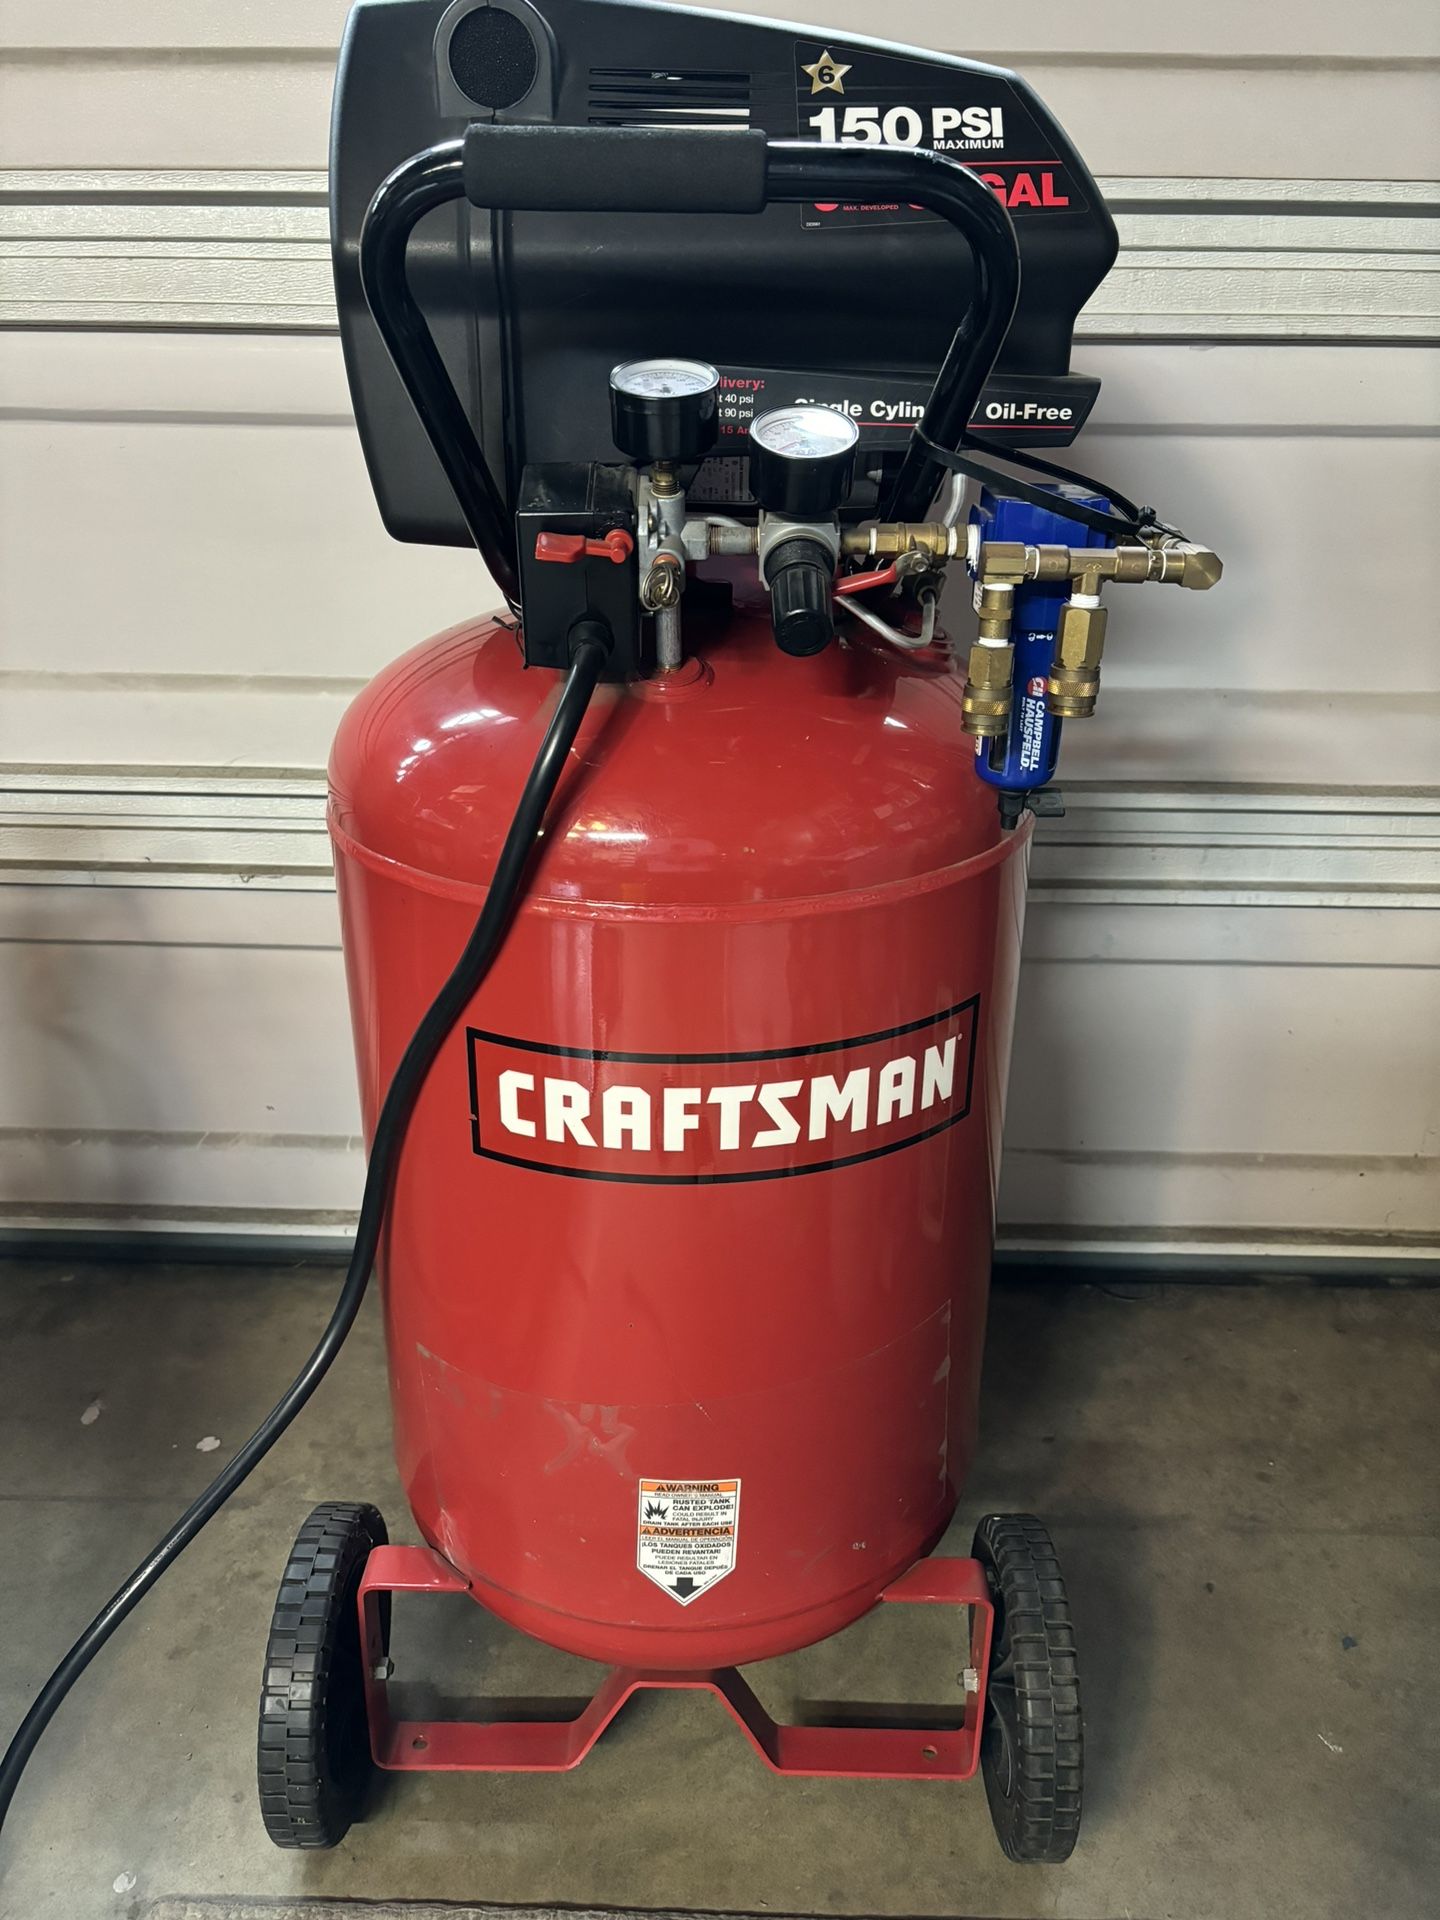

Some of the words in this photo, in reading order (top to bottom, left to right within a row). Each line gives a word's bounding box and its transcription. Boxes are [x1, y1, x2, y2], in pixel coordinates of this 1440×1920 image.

[818, 65, 836, 85] 6
[809, 106, 923, 148] 150
[931, 106, 1003, 139] PSI
[933, 140, 1004, 150] MAXIMUM
[725, 394, 737, 403] 40
[740, 394, 754, 406] psi
[724, 408, 737, 417] 90
[739, 408, 754, 420] psi
[870, 400, 925, 420] Cylin
[986, 402, 1073, 421] Oil-Free
[722, 426, 734, 434] 15
[1020, 698, 1036, 768] HAUSFELD
[1030, 700, 1046, 771] CAMPBELL
[499, 1035, 957, 1152] CRAFTSMAN
[666, 1484, 719, 1493] WARNING
[653, 1527, 730, 1536] ADVERTENCIA
